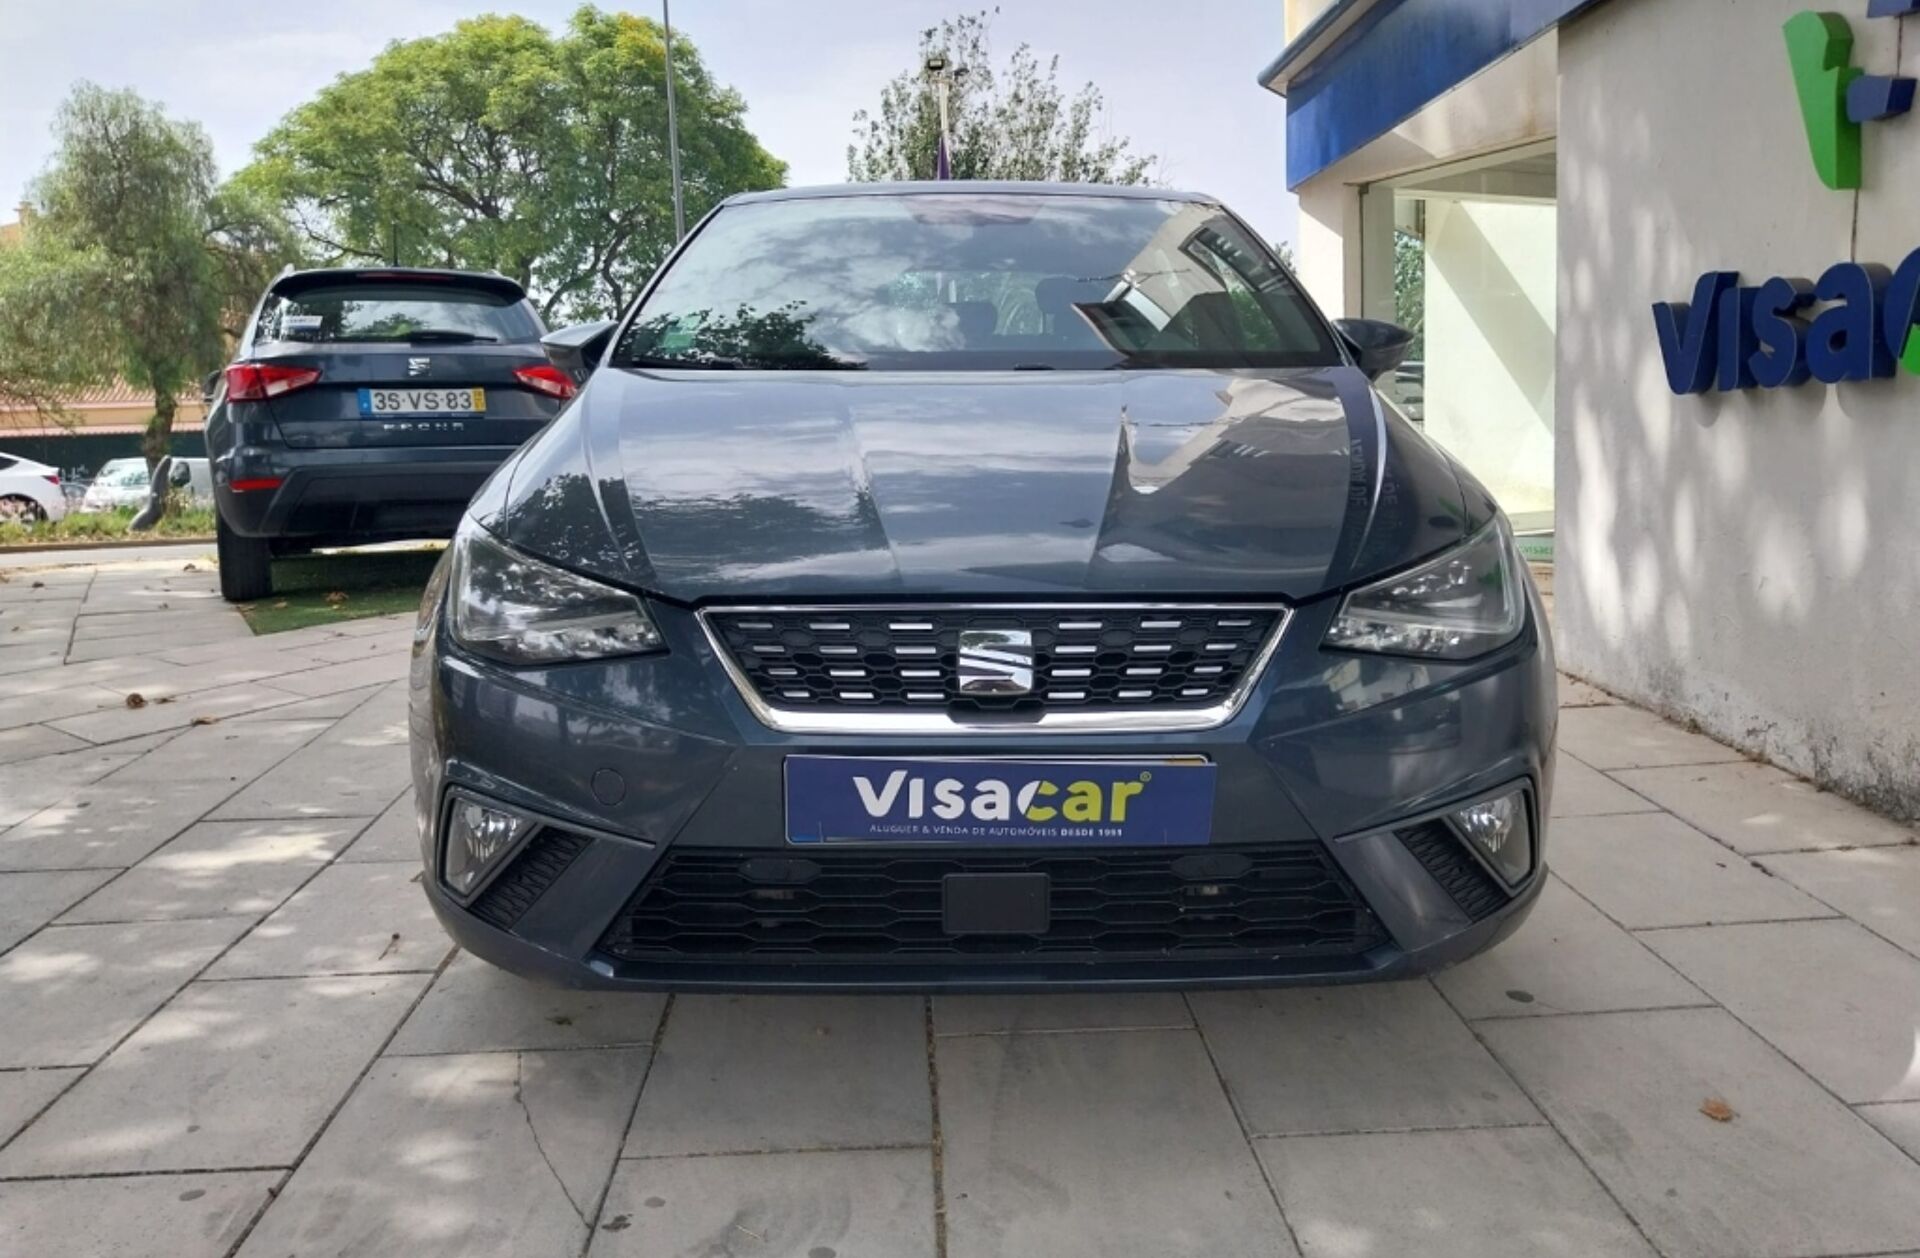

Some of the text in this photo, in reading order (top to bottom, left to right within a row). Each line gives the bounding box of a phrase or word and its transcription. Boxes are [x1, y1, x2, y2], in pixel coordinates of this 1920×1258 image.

[869, 824, 919, 834] ALUGUER
[922, 825, 930, 834] &
[933, 825, 968, 835] VENDA
[972, 826, 985, 836] DE
[988, 826, 1057, 836] AUTOMÓVEIS
[1060, 827, 1094, 837] DESDE
